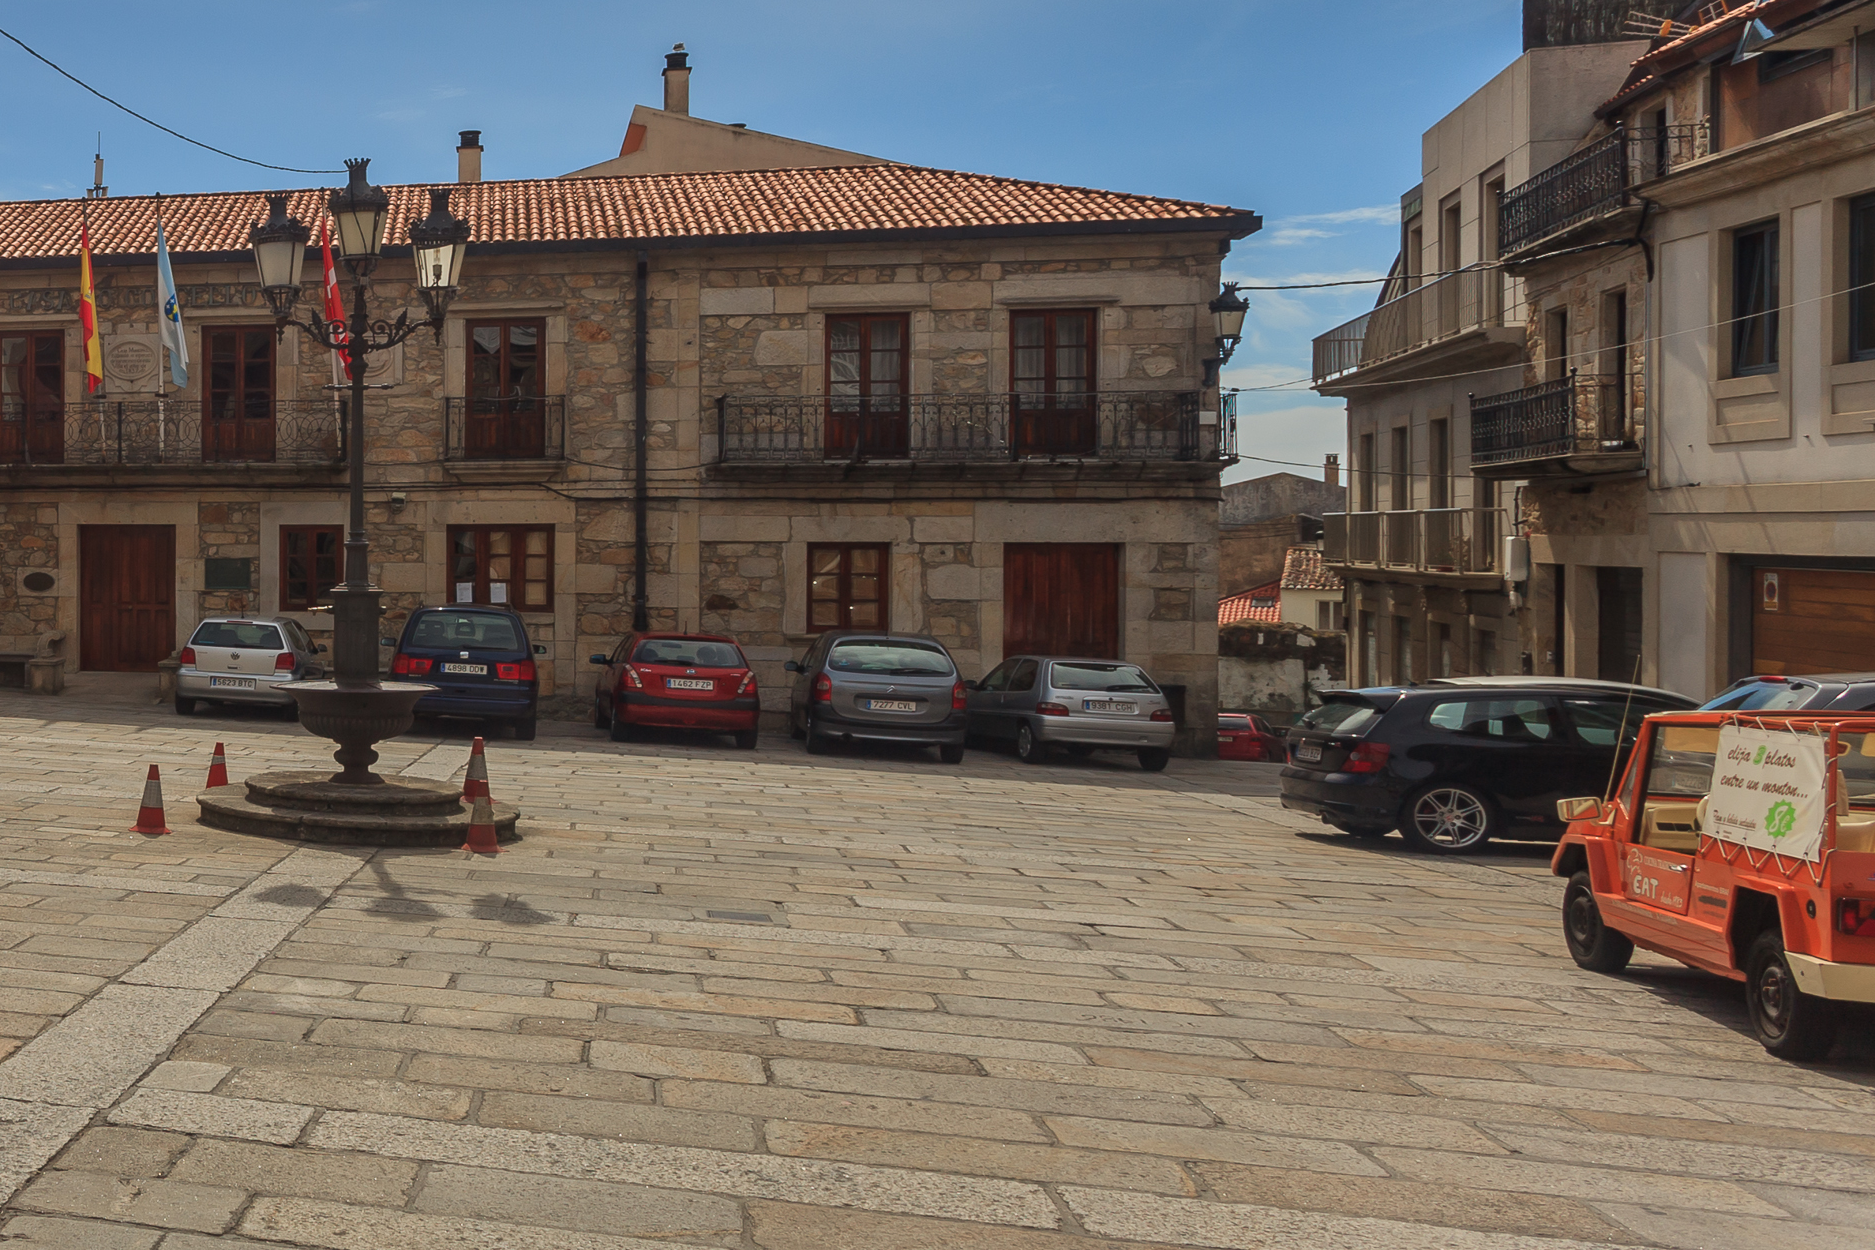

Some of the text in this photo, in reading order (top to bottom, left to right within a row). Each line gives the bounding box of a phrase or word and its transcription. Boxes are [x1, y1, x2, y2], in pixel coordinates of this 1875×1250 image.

[9, 290, 72, 311] CASA
[124, 284, 257, 309] COCELLO
[446, 664, 467, 672] 4898
[238, 679, 253, 687] BTC
[672, 679, 712, 689] 1462 FZP
[873, 700, 912, 710] 7277 CVL
[1091, 702, 1132, 712] 9381 CGH
[1727, 744, 1796, 769] elija 3 platos
[1720, 774, 1745, 789] entre
[1746, 779, 1759, 791] un
[1633, 874, 1659, 900] EAT
